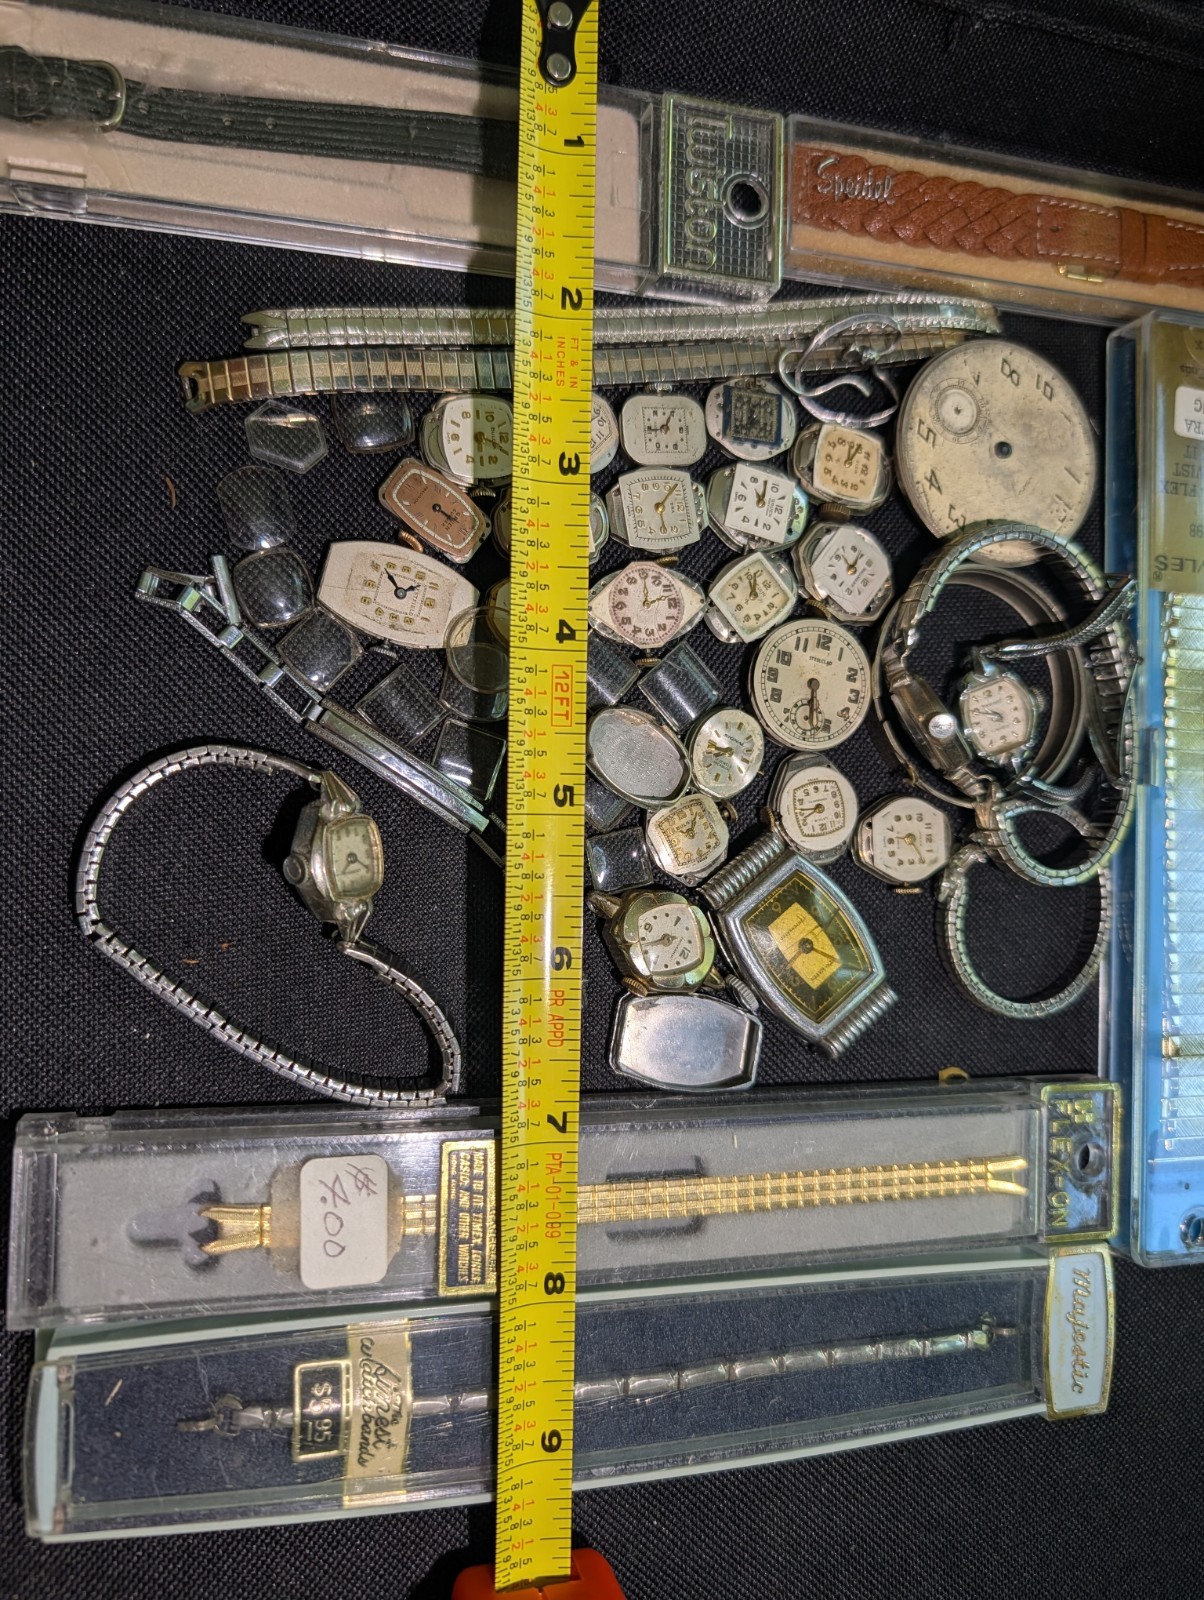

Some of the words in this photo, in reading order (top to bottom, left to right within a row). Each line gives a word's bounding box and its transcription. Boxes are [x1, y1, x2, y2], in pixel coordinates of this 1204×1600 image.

[564, 135, 584, 148] 1
[561, 286, 582, 311] 2
[570, 338, 578, 352] FT
[557, 336, 566, 387] INCHES
[1000, 358, 1020, 387] 8
[569, 376, 578, 388] IN
[461, 411, 471, 419] 8
[485, 411, 495, 423] 10
[450, 433, 460, 442] 6
[499, 433, 510, 444] 12
[918, 419, 936, 448] 5
[465, 454, 474, 464] 4
[488, 455, 498, 465] 2
[559, 452, 580, 476] 3
[924, 469, 942, 495] 4
[556, 619, 576, 644] 4
[795, 636, 808, 653] 11
[816, 634, 833, 651] 12
[776, 649, 792, 666] 10
[846, 667, 858, 683] 2
[848, 689, 860, 704] 3
[554, 784, 574, 807] 5
[551, 946, 572, 971] 6
[549, 990, 564, 1006] PR
[547, 1014, 564, 1047] APPD
[547, 1111, 567, 1134] 7
[544, 1272, 565, 1295] 8
[1065, 1268, 1093, 1394] Majestic
[541, 1429, 562, 1453] 9
